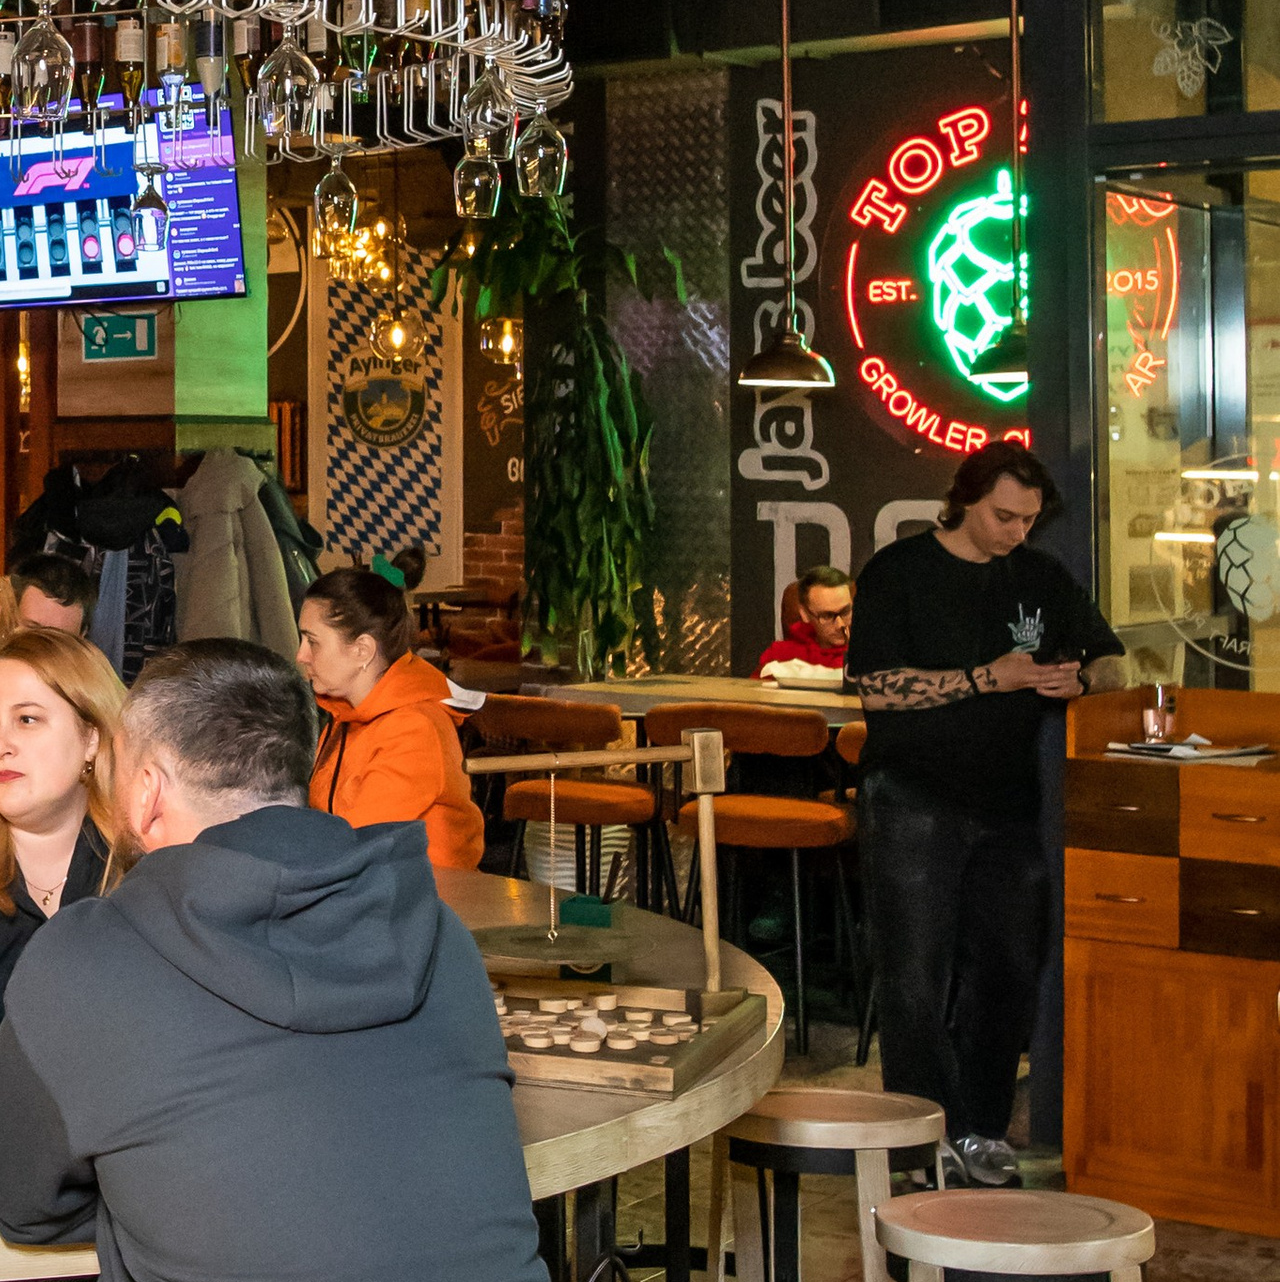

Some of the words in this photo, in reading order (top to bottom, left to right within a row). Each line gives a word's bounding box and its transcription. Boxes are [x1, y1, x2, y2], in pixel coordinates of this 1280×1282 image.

[850, 107, 990, 233] TOP
[868, 280, 919, 302] EST.
[859, 355, 987, 454] GROWLER
